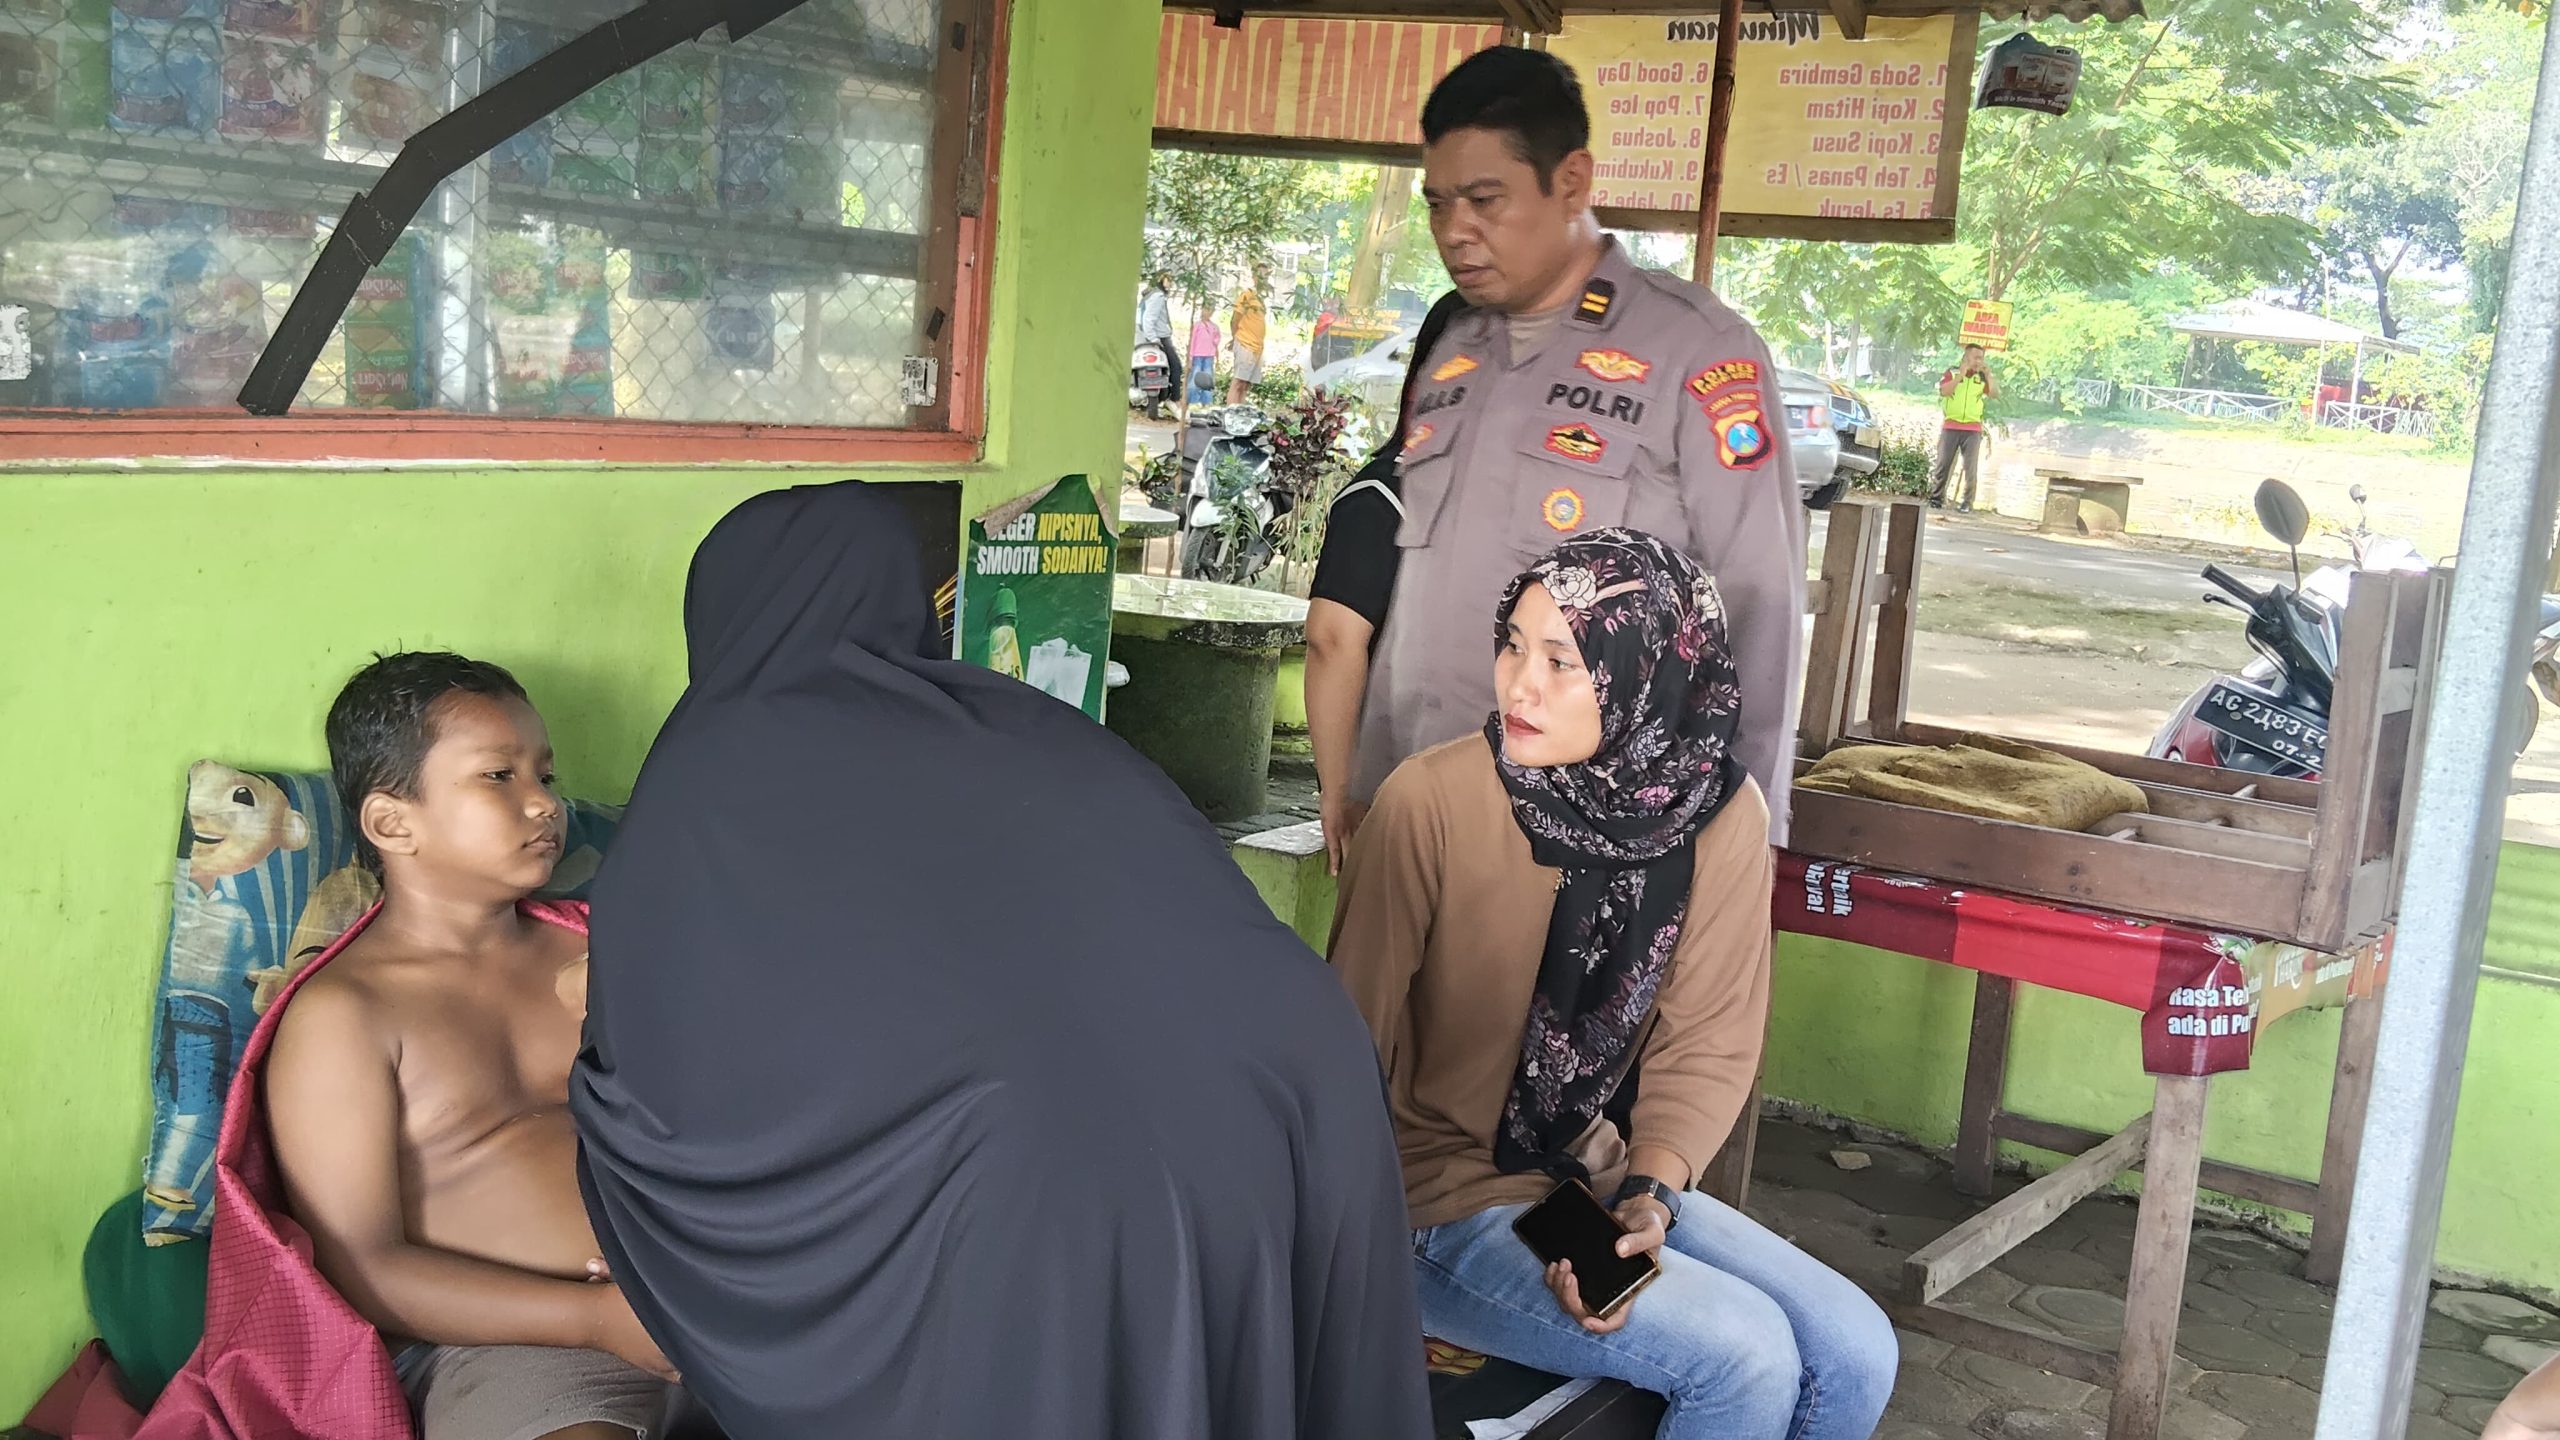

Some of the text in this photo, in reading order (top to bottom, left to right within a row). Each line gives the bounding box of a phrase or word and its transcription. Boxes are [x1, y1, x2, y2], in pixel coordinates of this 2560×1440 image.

[1545, 383, 1644, 425] POLRI
[989, 512, 1102, 544] EGER NIPISNYA,
[977, 546, 1109, 576] SMOOTH SODANYA!
[2210, 689, 2243, 711] AG
[1831, 866, 1852, 917] erbaik
[2169, 986, 2221, 1008] Rasa
[2168, 1012, 2250, 1036] ada di Pu
